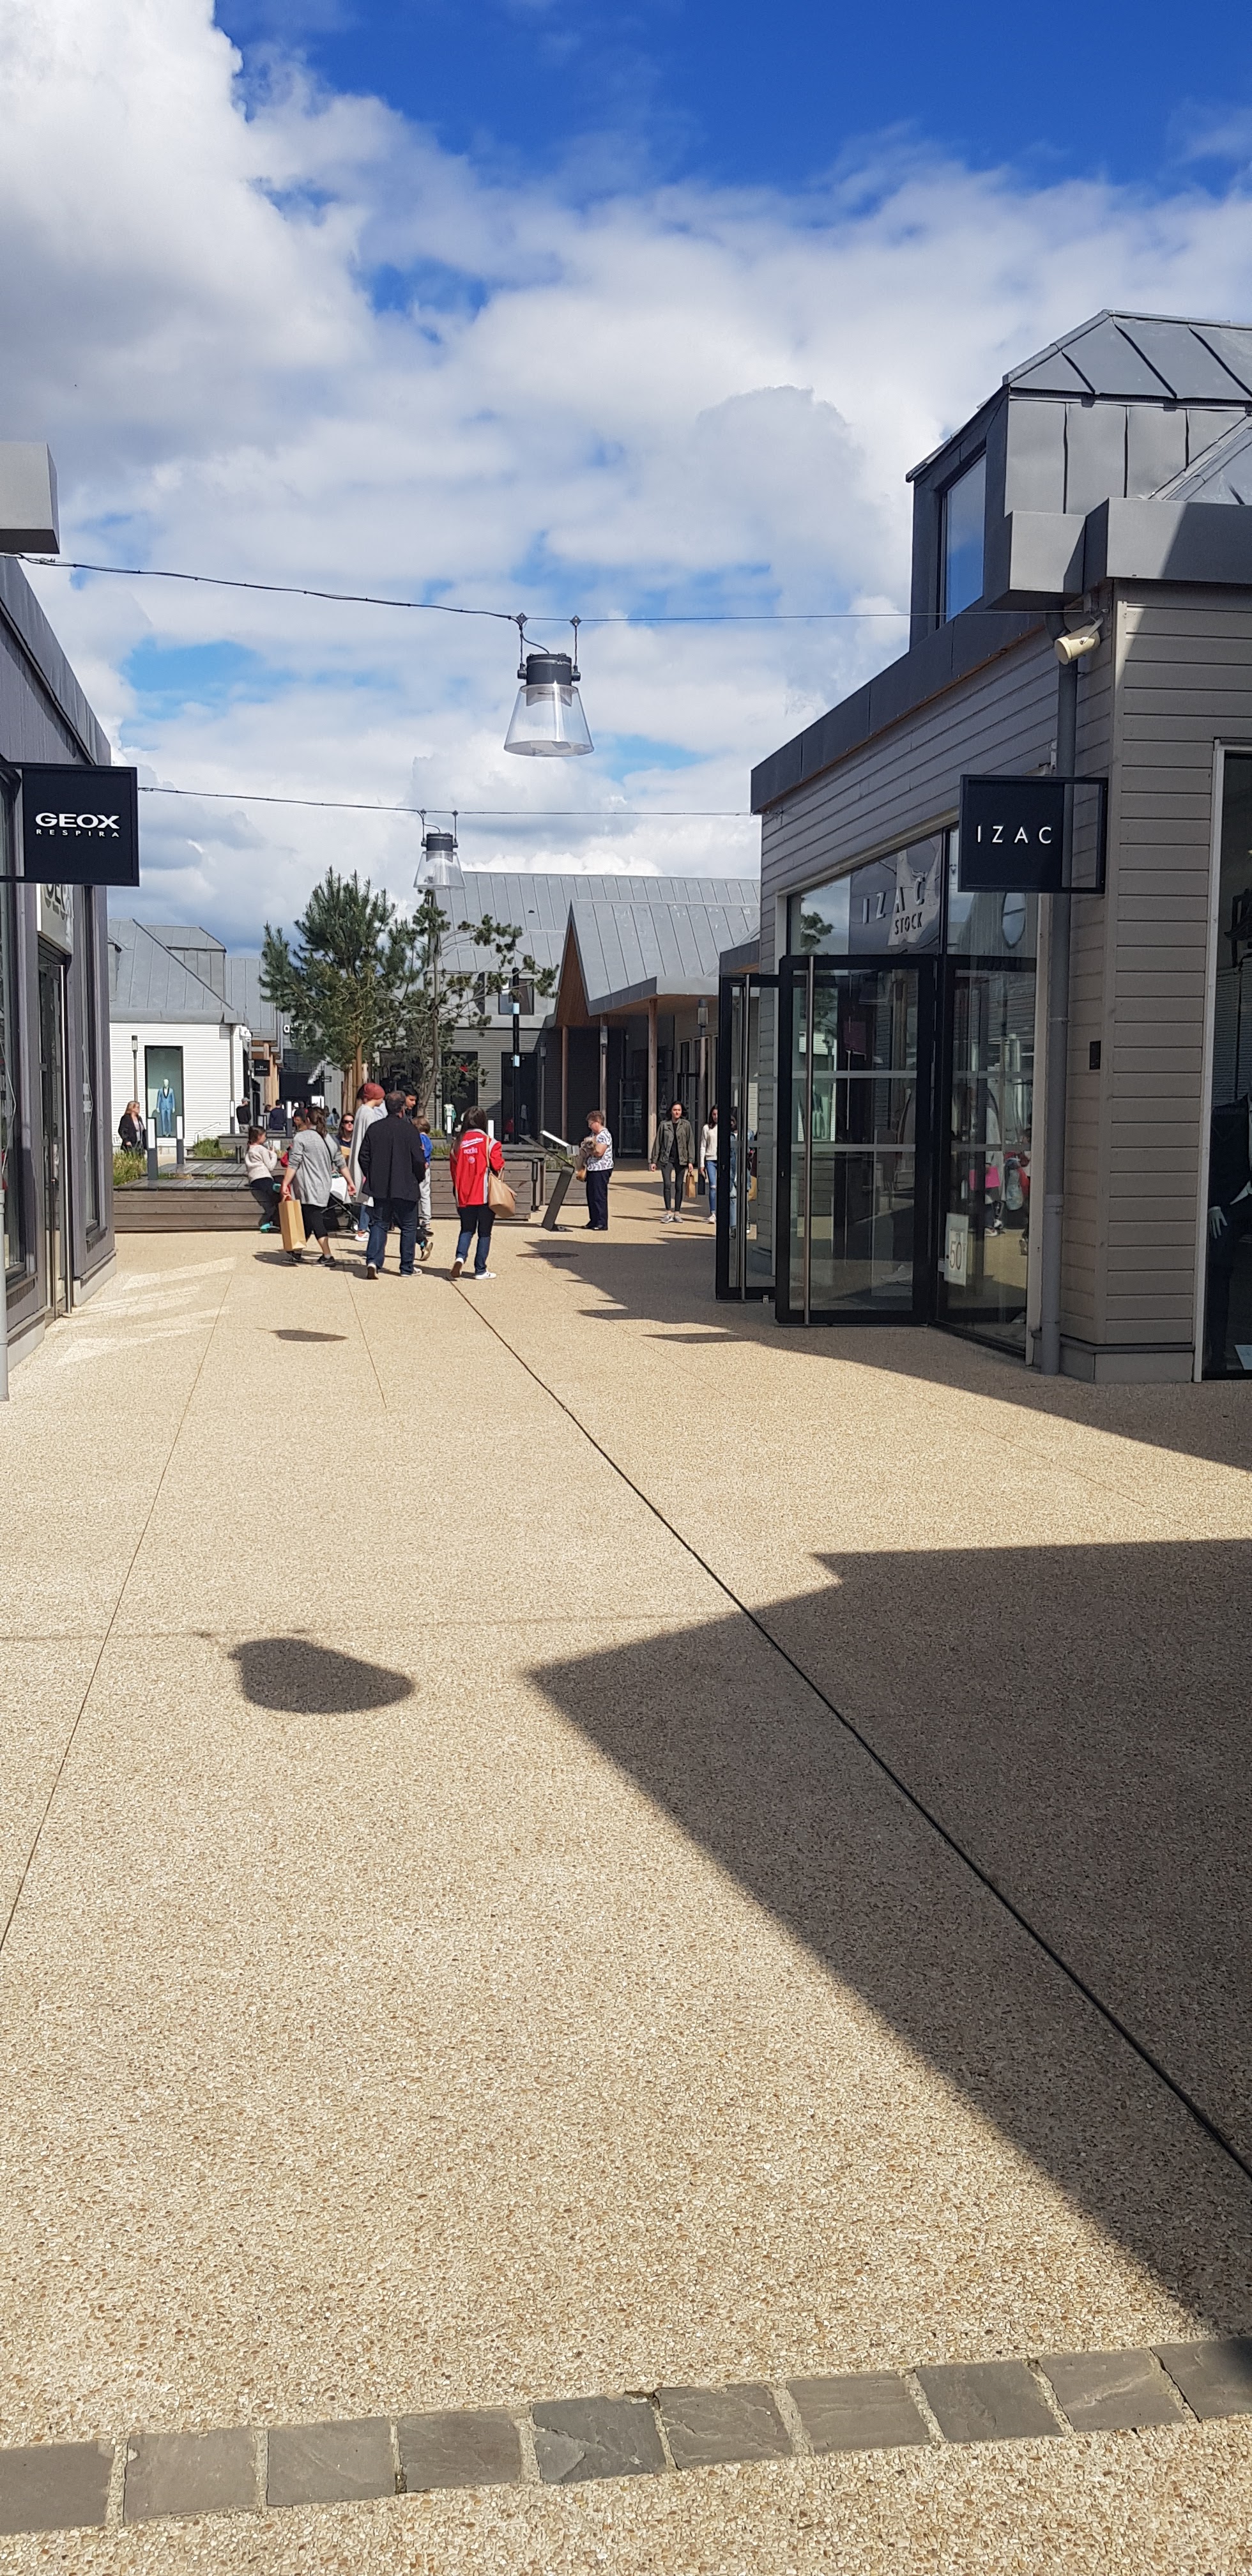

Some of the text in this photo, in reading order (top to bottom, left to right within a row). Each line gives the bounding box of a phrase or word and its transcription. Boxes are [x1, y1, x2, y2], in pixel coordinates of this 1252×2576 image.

[35, 812, 120, 829] GEOX
[36, 829, 119, 838] RESPIRA
[977, 825, 1052, 844] IZAC
[862, 877, 926, 924] IZAC
[894, 912, 923, 935] STOCK
